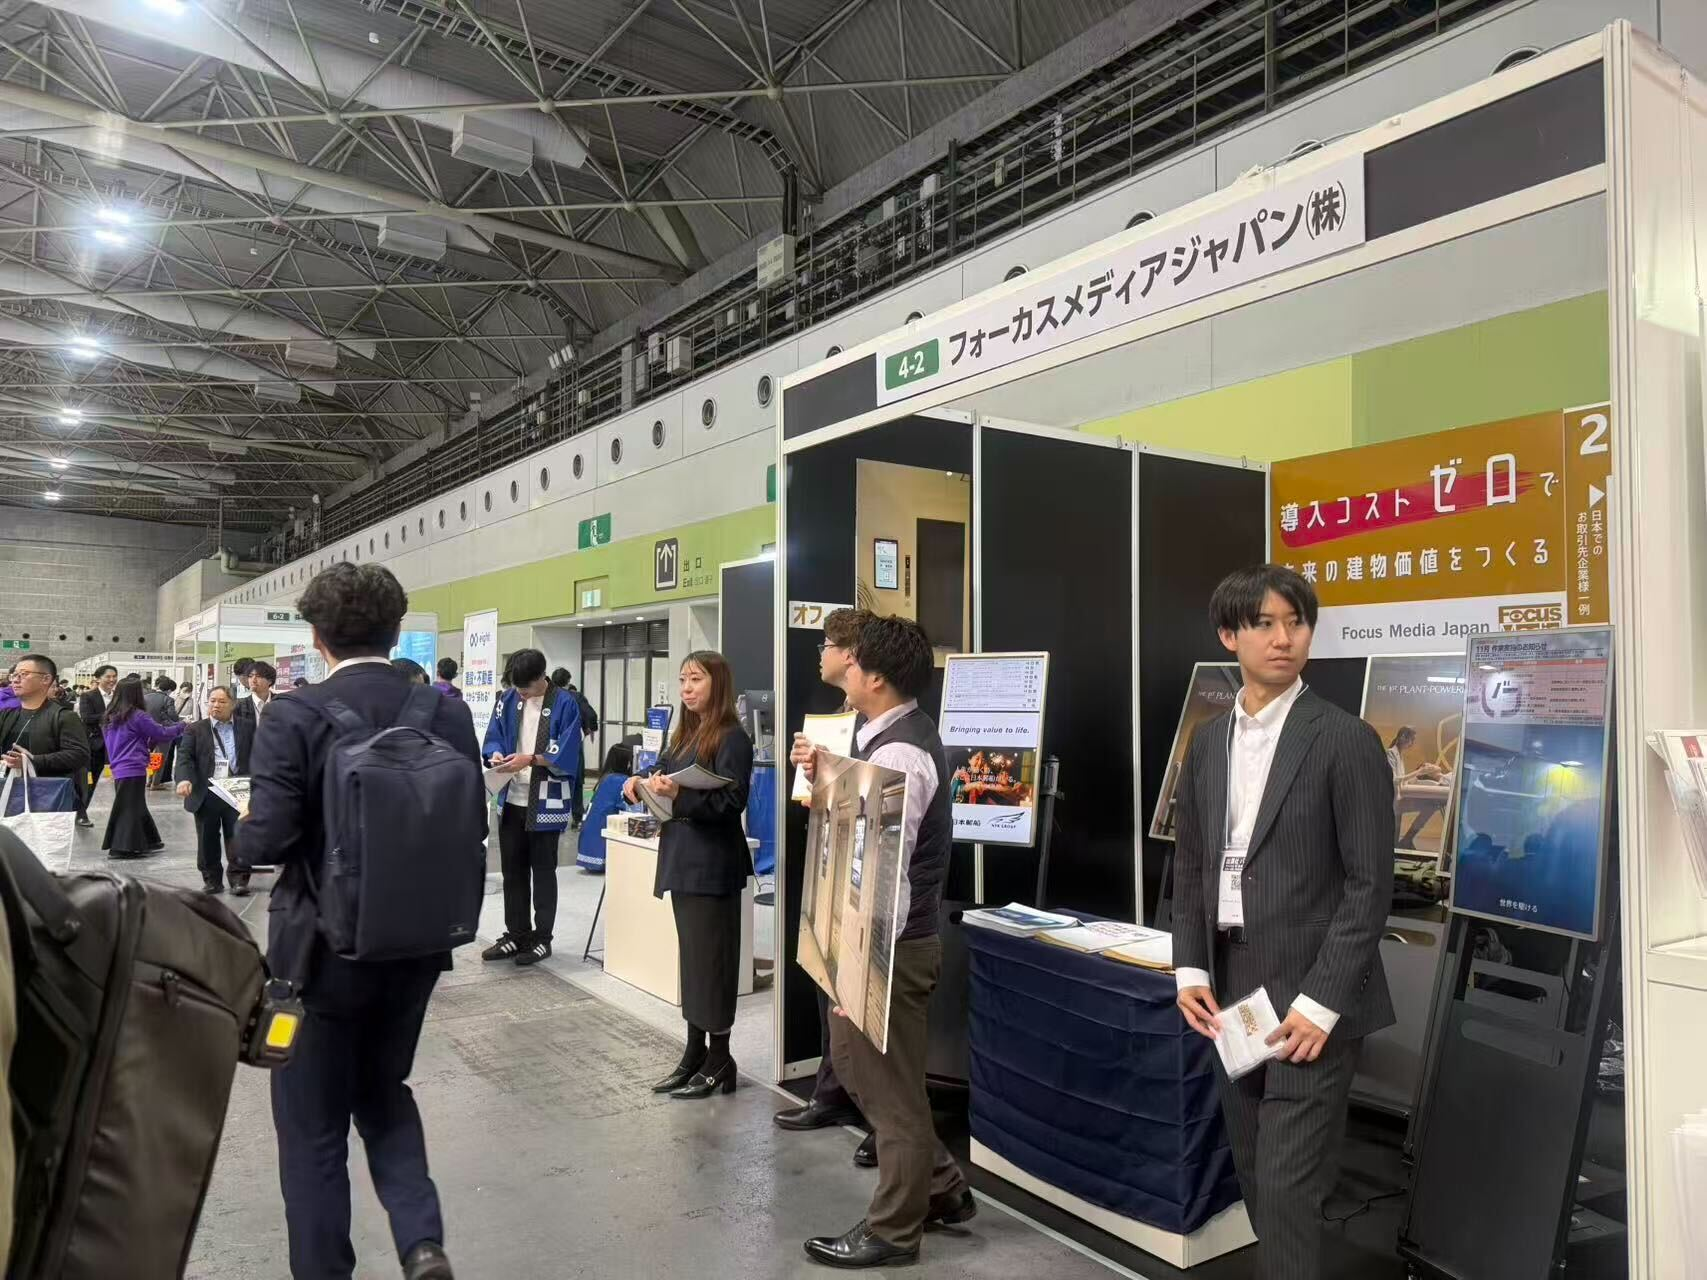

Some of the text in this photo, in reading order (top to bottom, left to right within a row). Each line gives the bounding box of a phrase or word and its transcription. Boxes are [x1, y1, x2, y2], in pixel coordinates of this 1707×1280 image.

[898, 180, 1347, 378] 4-2 フォーカスメディアジャパン(株)
[1580, 413, 1608, 455] 2
[1280, 453, 1559, 532] 導入コストゼロで
[1591, 509, 1602, 556] 日本での
[1576, 511, 1590, 616] お取引先企業様一例
[793, 603, 823, 625] オフ
[1342, 626, 1383, 640] Focus
[1389, 622, 1436, 638] Media
[1441, 621, 1490, 636] Japan
[949, 726, 981, 735] Bringing
[1015, 726, 1030, 734] life.
[1499, 899, 1538, 913] 世界を駆ける
